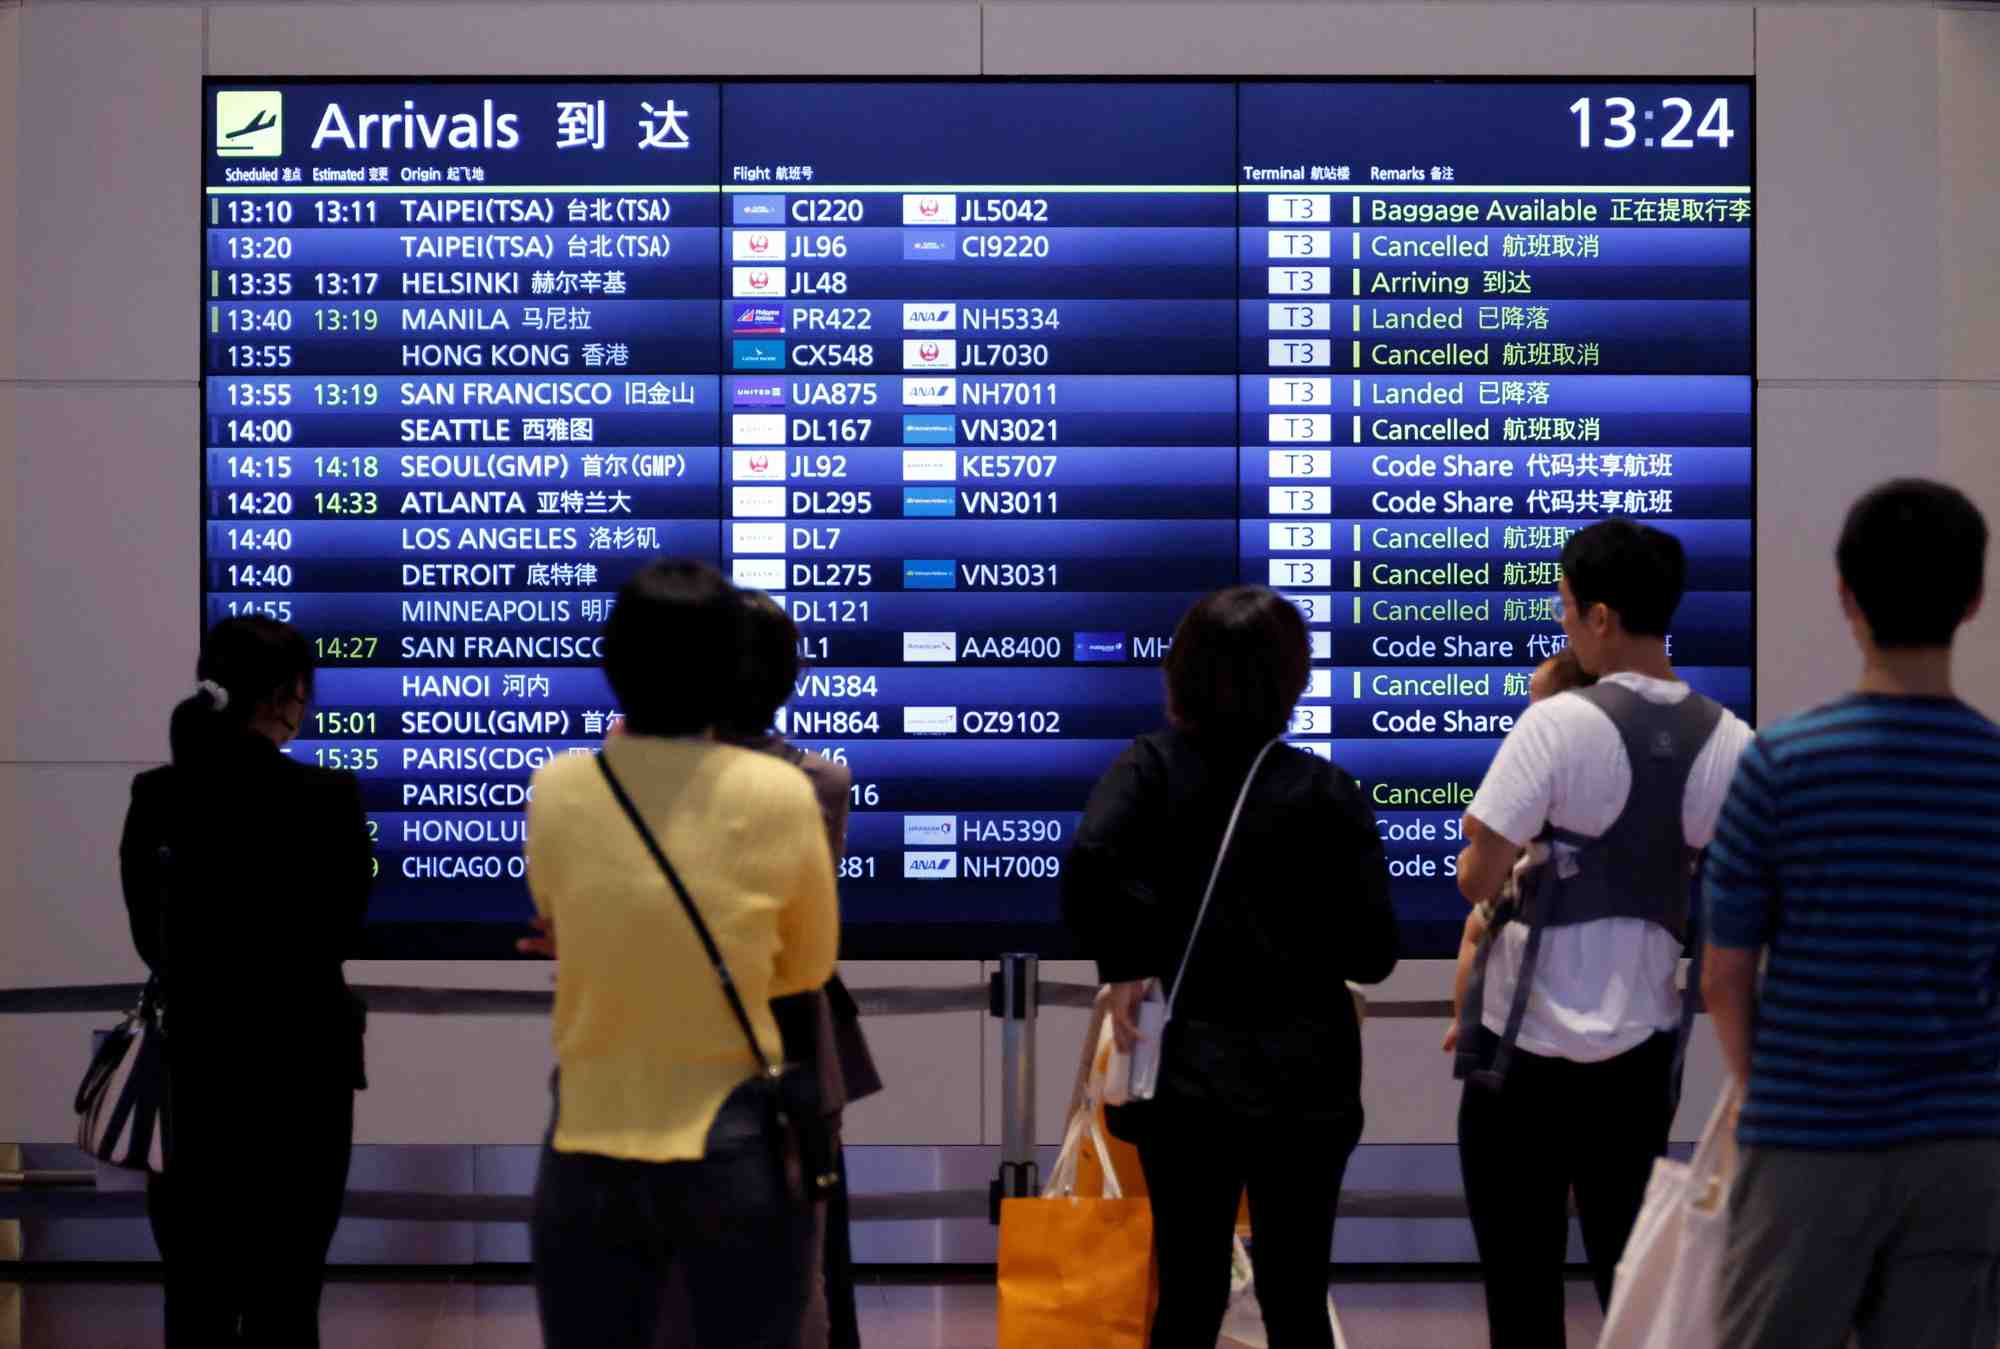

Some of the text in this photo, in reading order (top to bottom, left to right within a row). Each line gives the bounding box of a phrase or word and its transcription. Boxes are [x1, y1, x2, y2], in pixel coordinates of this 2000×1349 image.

[312, 99, 519, 148] Arrivals
[557, 100, 689, 149] 到 达
[1570, 97, 1734, 148] 13:24
[226, 168, 278, 181] Scheduled
[313, 167, 364, 181] Estimated
[401, 167, 441, 182] Origin
[733, 166, 813, 182] Flight 航班号
[1244, 166, 1304, 180] Terminal
[1371, 166, 1425, 180] Remarks
[229, 201, 292, 222] 13:10
[315, 200, 375, 222] 13:11
[400, 198, 670, 223] TAIPEI(TSA) 台北(TSA)
[792, 199, 863, 221] CI220
[961, 200, 1047, 221] JL5042
[1285, 199, 1312, 218] T3
[1372, 198, 1751, 222] Baggage Available 正在提取行李
[229, 237, 291, 258] 13:20
[400, 234, 670, 259] TAIPEI(TSA) 台北(TSA)
[791, 236, 847, 257] JL96
[963, 235, 1049, 257] CI9220
[1284, 235, 1313, 255] T3
[1372, 233, 1599, 257] Cancelled 航班取消
[228, 273, 291, 295] 13:35
[315, 273, 378, 294] 13:17
[403, 270, 626, 294] HELSINKI 赫尔辛基
[791, 272, 847, 293] JL48
[1284, 271, 1313, 291] T3
[1371, 270, 1531, 294] Arriving 到达
[228, 309, 291, 331] 13:40
[315, 309, 377, 330] 13:19
[403, 307, 591, 330] MANILA 马尼拉
[793, 308, 871, 329] PR422
[910, 308, 935, 321] ANA
[963, 308, 1059, 329] NH5334
[1284, 307, 1313, 327] T3
[1373, 306, 1549, 329] Landed 已降落
[229, 346, 291, 367] 13:55
[403, 343, 628, 366] HONG KONG 香港
[792, 344, 873, 366] CX548
[961, 345, 1048, 366] JL7030
[1284, 343, 1313, 363] T3
[1372, 342, 1598, 365] Cancelled 航班取消
[228, 384, 291, 406] 13:55
[315, 384, 377, 405] 13:19
[401, 381, 694, 405] SAN FRANCISCO 旧金山
[793, 383, 877, 404] UA875
[910, 384, 935, 397] ANA
[963, 383, 1055, 404] NH7011
[1285, 382, 1313, 402] T3
[1373, 381, 1550, 404] Landed 已降落
[228, 420, 292, 442] 14:00
[401, 418, 592, 441] SEATTLE 西雅图
[793, 419, 871, 441] DL167
[961, 419, 1056, 441] VN3021
[1285, 418, 1313, 438] T3
[1372, 417, 1599, 440] Cancelled 航班取消
[228, 456, 291, 478] 14:15
[315, 456, 378, 477] 14:18
[401, 453, 685, 478] SEOUL(GMP) 首尔(GMP)
[791, 455, 846, 477] JL92
[963, 455, 1057, 477] KE5707
[1285, 455, 1313, 474] T3
[1372, 453, 1672, 477] Code Share 代码共享航班
[228, 492, 292, 514] 14:20
[315, 492, 377, 513] 14:33
[401, 490, 631, 513] ATLANTA 亚特兰大
[793, 492, 871, 513] DL295
[961, 492, 1056, 513] VN3011
[1285, 491, 1314, 510] T3
[1372, 489, 1672, 513] Code Share 代码共享航班
[228, 528, 291, 550] 14:40
[403, 526, 660, 549] LOS ANGELES 洛杉矶
[793, 528, 840, 549] DL7
[1285, 527, 1313, 547] T3
[1373, 526, 1575, 549] Cancelled 航班取
[229, 565, 291, 586] 14:40
[403, 563, 597, 586] DETROIT 底特律
[793, 564, 871, 585] DL275
[962, 564, 1056, 585] VN3031
[1285, 563, 1313, 583] T3
[1373, 561, 1563, 585] Cancelled 航班
[403, 600, 570, 621] MINNEAPOLIS
[793, 601, 867, 622] DL121
[1373, 599, 1488, 620] Cancelled
[316, 637, 377, 658] 14:27
[402, 637, 454, 658] SAN
[962, 637, 1060, 658] AA8400
[1373, 635, 1436, 657] Code
[1444, 635, 1513, 657] Share
[403, 674, 548, 697] HANOI 河内
[796, 675, 878, 697] VN384
[1373, 674, 1488, 695] Cancelled
[316, 712, 374, 733] 15:01
[402, 710, 568, 734] SEOUL(GMP)
[794, 712, 879, 733] NH864
[963, 712, 1059, 733] OZ9102
[1373, 710, 1514, 732] Code Share
[316, 748, 378, 769] 15:35
[403, 782, 534, 808] PARIS(CD
[1373, 783, 1474, 804] Cancelle
[403, 819, 528, 842] HONOLUL
[964, 820, 1061, 841] HA5390
[1376, 818, 1436, 840] Code
[403, 856, 501, 878] CHICAGO
[910, 860, 938, 871] ANA
[964, 856, 1059, 877] NH7009
[1389, 854, 1436, 876] ode
